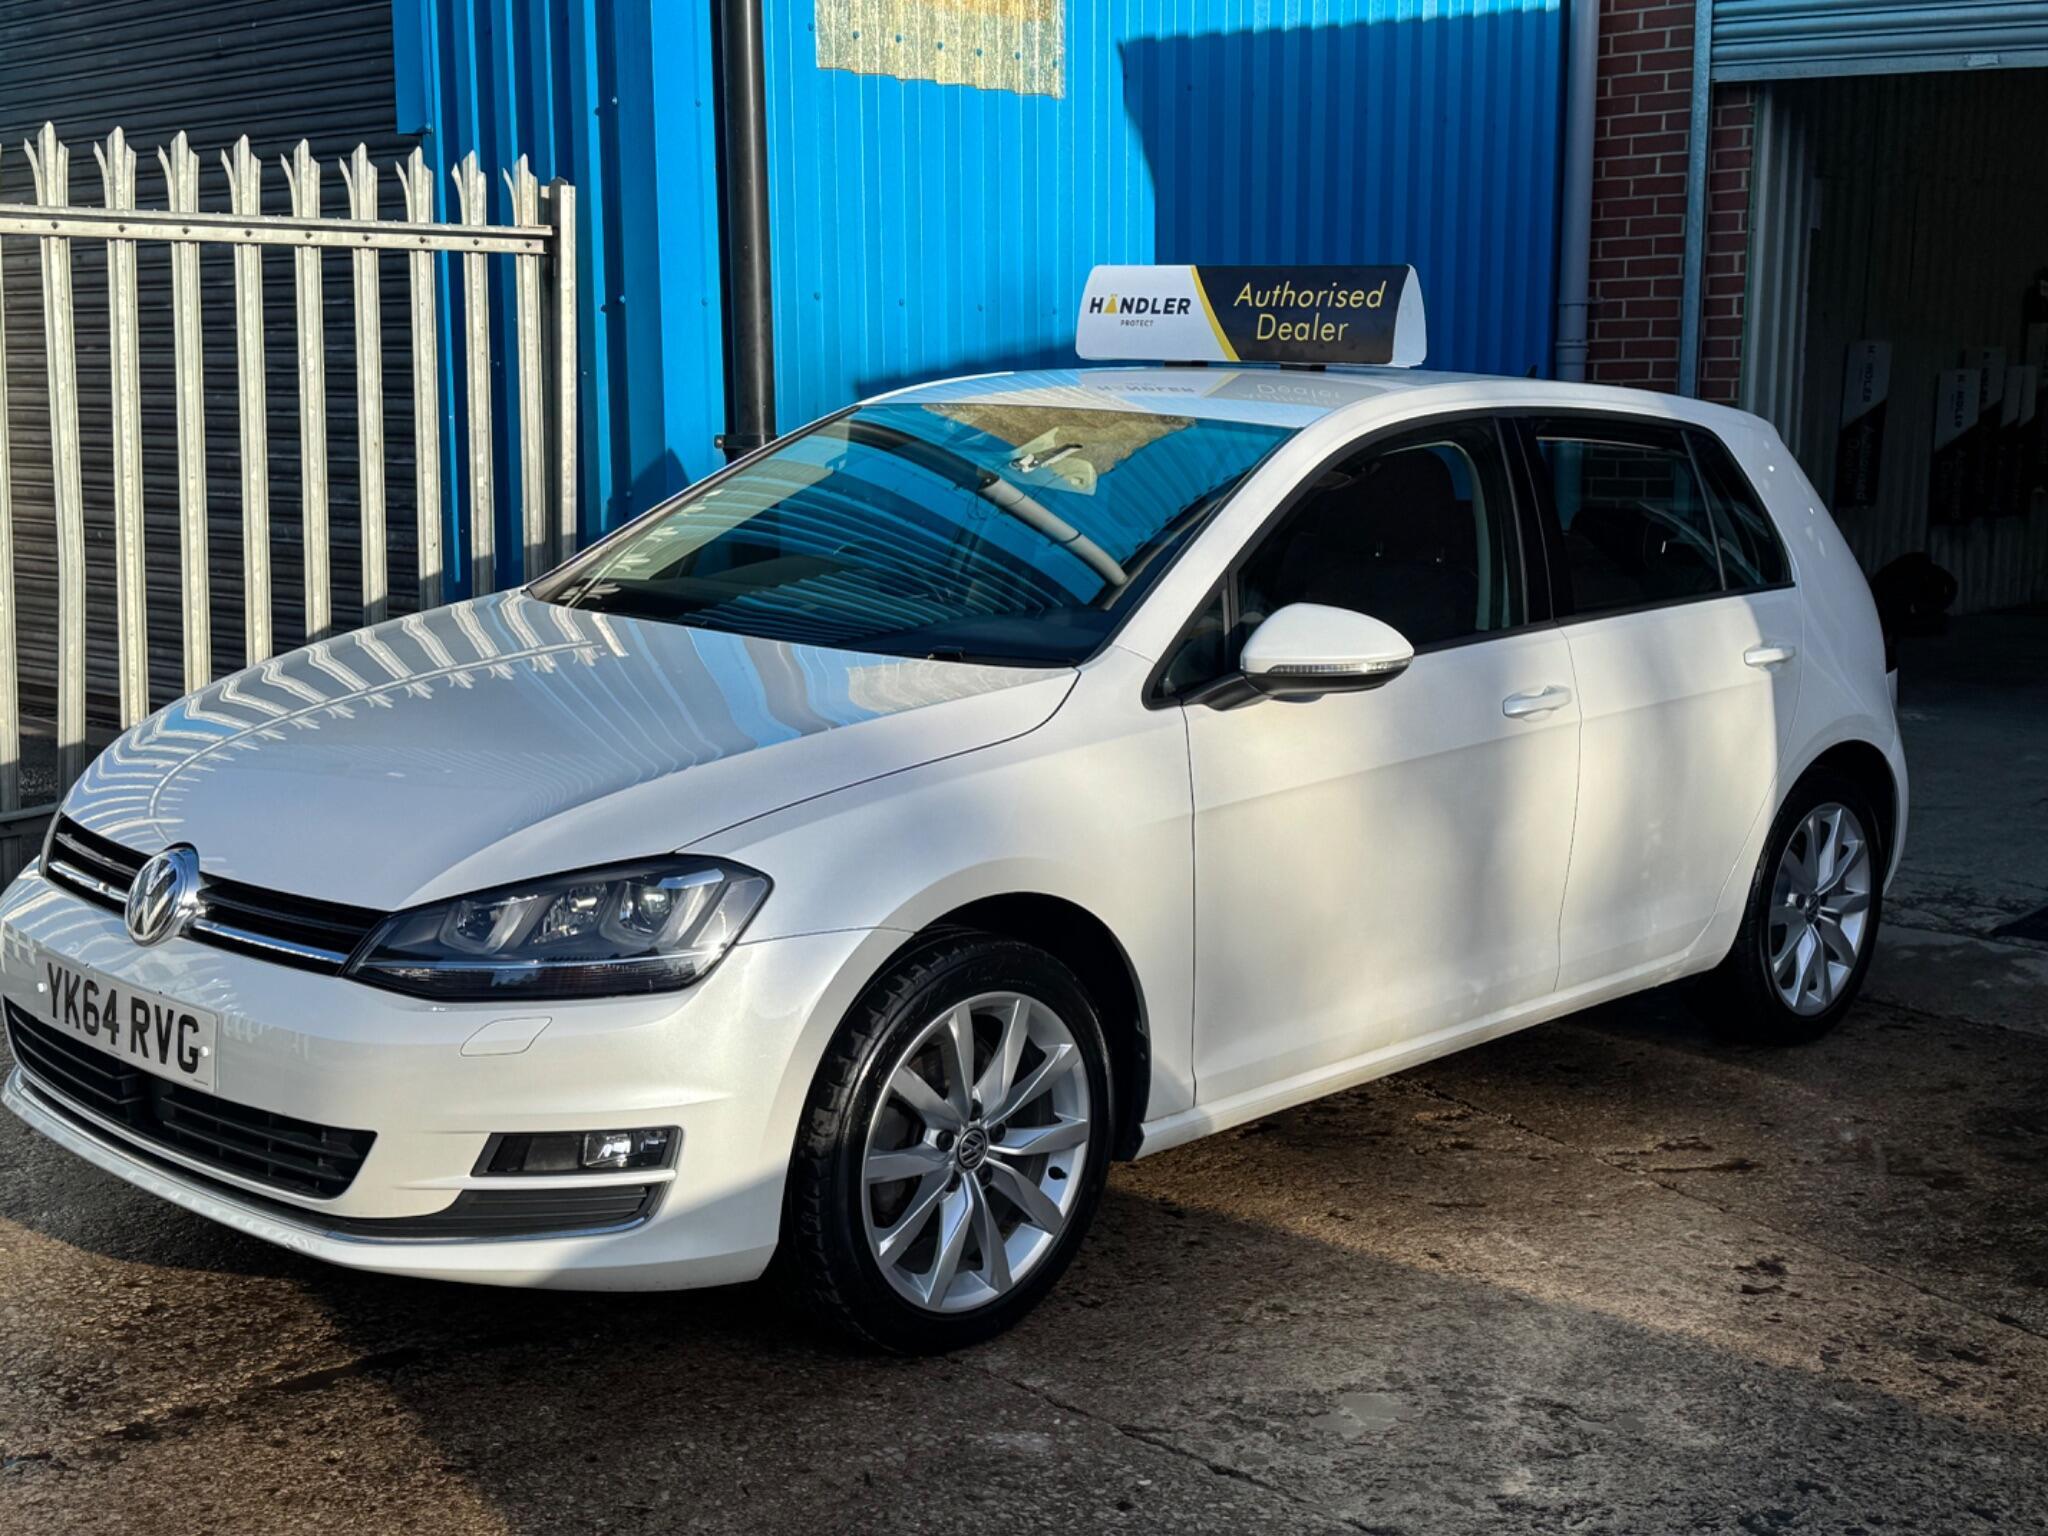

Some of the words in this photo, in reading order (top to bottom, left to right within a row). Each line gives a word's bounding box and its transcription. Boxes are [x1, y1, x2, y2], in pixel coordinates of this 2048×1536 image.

[1233, 280, 1387, 309] Authorised
[1120, 319, 1154, 327] PROTECT
[1256, 312, 1349, 342] Dealer
[47, 962, 120, 1047] YK64
[130, 995, 200, 1075] RVG
